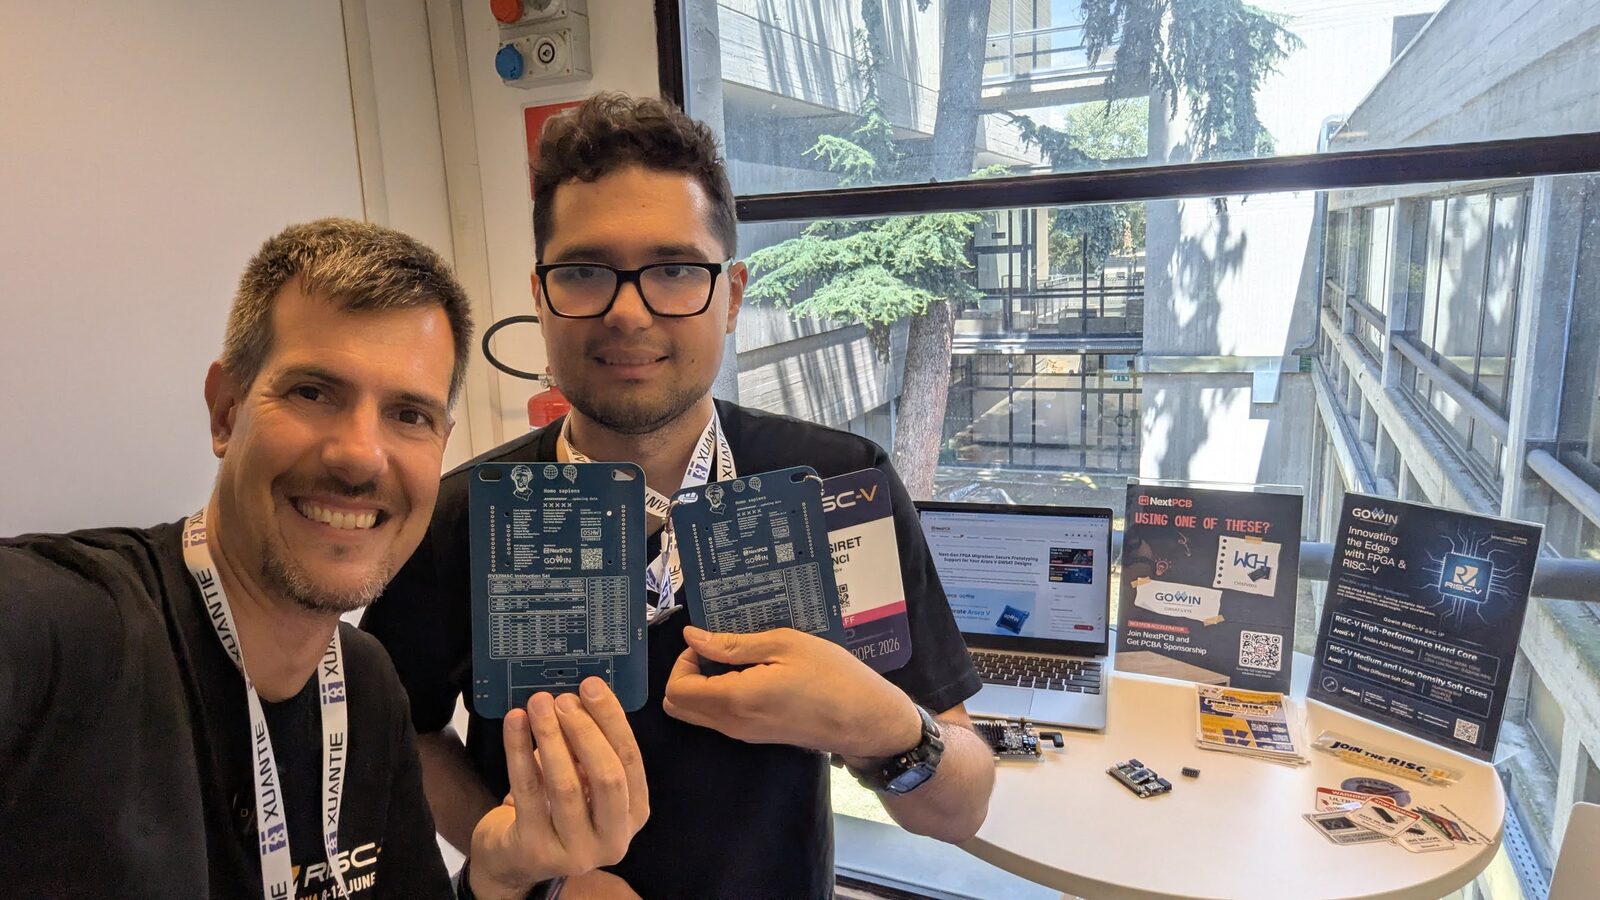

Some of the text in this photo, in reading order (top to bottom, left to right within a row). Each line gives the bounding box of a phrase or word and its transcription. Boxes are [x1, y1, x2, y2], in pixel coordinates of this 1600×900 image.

[697, 424, 716, 464] XUAN
[720, 430, 733, 479] XUAN
[822, 484, 878, 512] SC-V
[1150, 496, 1192, 508] NextPCB
[1135, 512, 1272, 534] USING ONE OF THESE?
[1352, 508, 1398, 524] GOWIN
[1348, 526, 1398, 545] Innovating
[1347, 538, 1390, 554] the Edge
[544, 554, 572, 564] GOWIN
[1342, 559, 1380, 574] RISC-V
[1345, 549, 1406, 570] with FPGA &
[1155, 591, 1201, 605] GOWIN
[1444, 581, 1482, 595] RISC-V
[196, 568, 241, 662] XUANTIE
[1383, 616, 1401, 625] Gowin
[1402, 621, 1424, 632] RISC-V
[1143, 632, 1174, 641] NextPCB
[1335, 615, 1478, 660] RISC-V High-Performance Hard Core
[852, 637, 900, 660] ROPE 2026
[1140, 640, 1162, 648] PCBA
[1163, 643, 1207, 656] Sponsorship
[1330, 644, 1353, 656] RISC-V
[1353, 651, 1382, 665] Medium
[1383, 662, 1398, 671] and
[1399, 665, 1446, 686] Low-Density
[1447, 681, 1463, 692] Soft
[1464, 686, 1488, 699] Cores
[1370, 668, 1390, 678] Different
[1401, 678, 1415, 687] Cores
[1342, 687, 1360, 696] Contact
[1330, 742, 1362, 753] JOIN
[1365, 752, 1386, 761] THE
[1388, 758, 1426, 772] RISC
[255, 720, 279, 823] XUANTIE
[327, 732, 343, 826] XUANTIE
[1332, 790, 1369, 800] WARNIN
[304, 842, 382, 887] RISC-
[346, 872, 376, 894] JUNE
